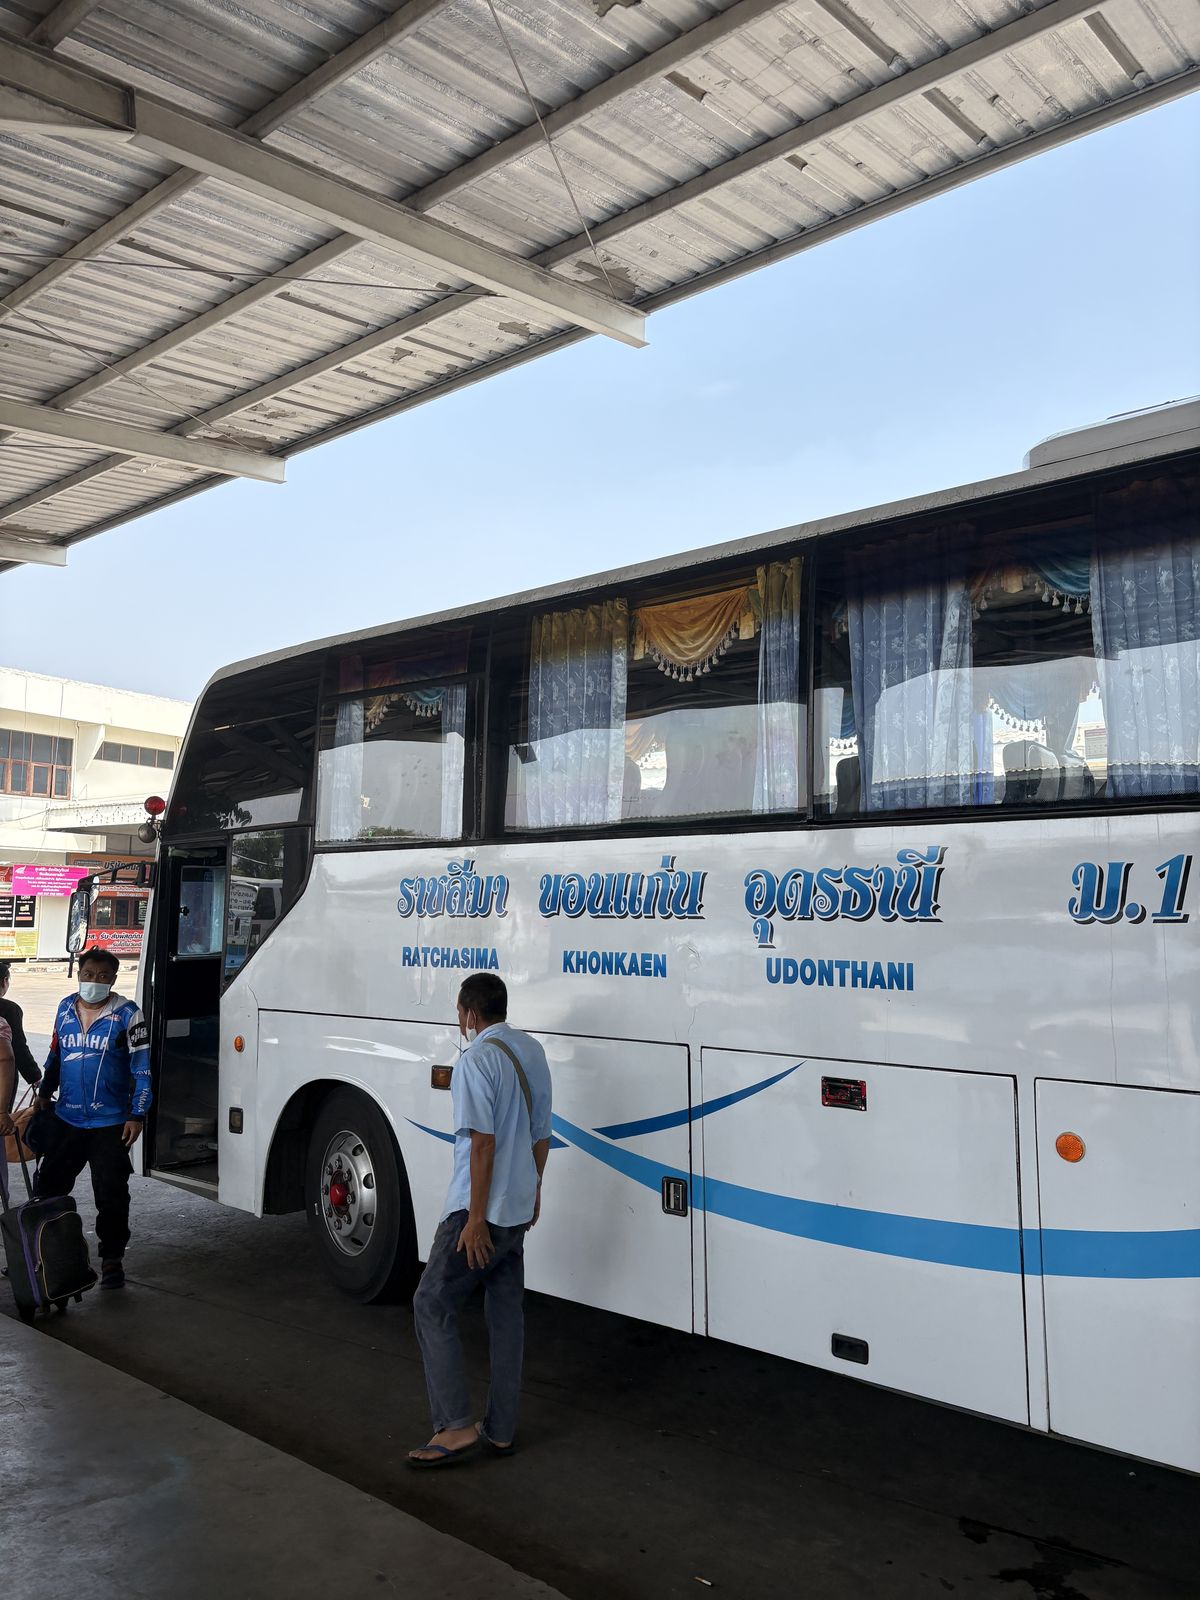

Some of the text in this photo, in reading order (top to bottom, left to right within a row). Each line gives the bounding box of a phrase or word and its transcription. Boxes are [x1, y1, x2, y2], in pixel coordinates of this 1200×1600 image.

[397, 859, 510, 918] ราชสีมา
[538, 855, 706, 919] ขอนแก่น
[744, 846, 949, 949] อุดรธานี
[402, 947, 913, 991] RATCHASIMA KHONKAEN UDONTHANI
[61, 1033, 109, 1051] YAMAHA
